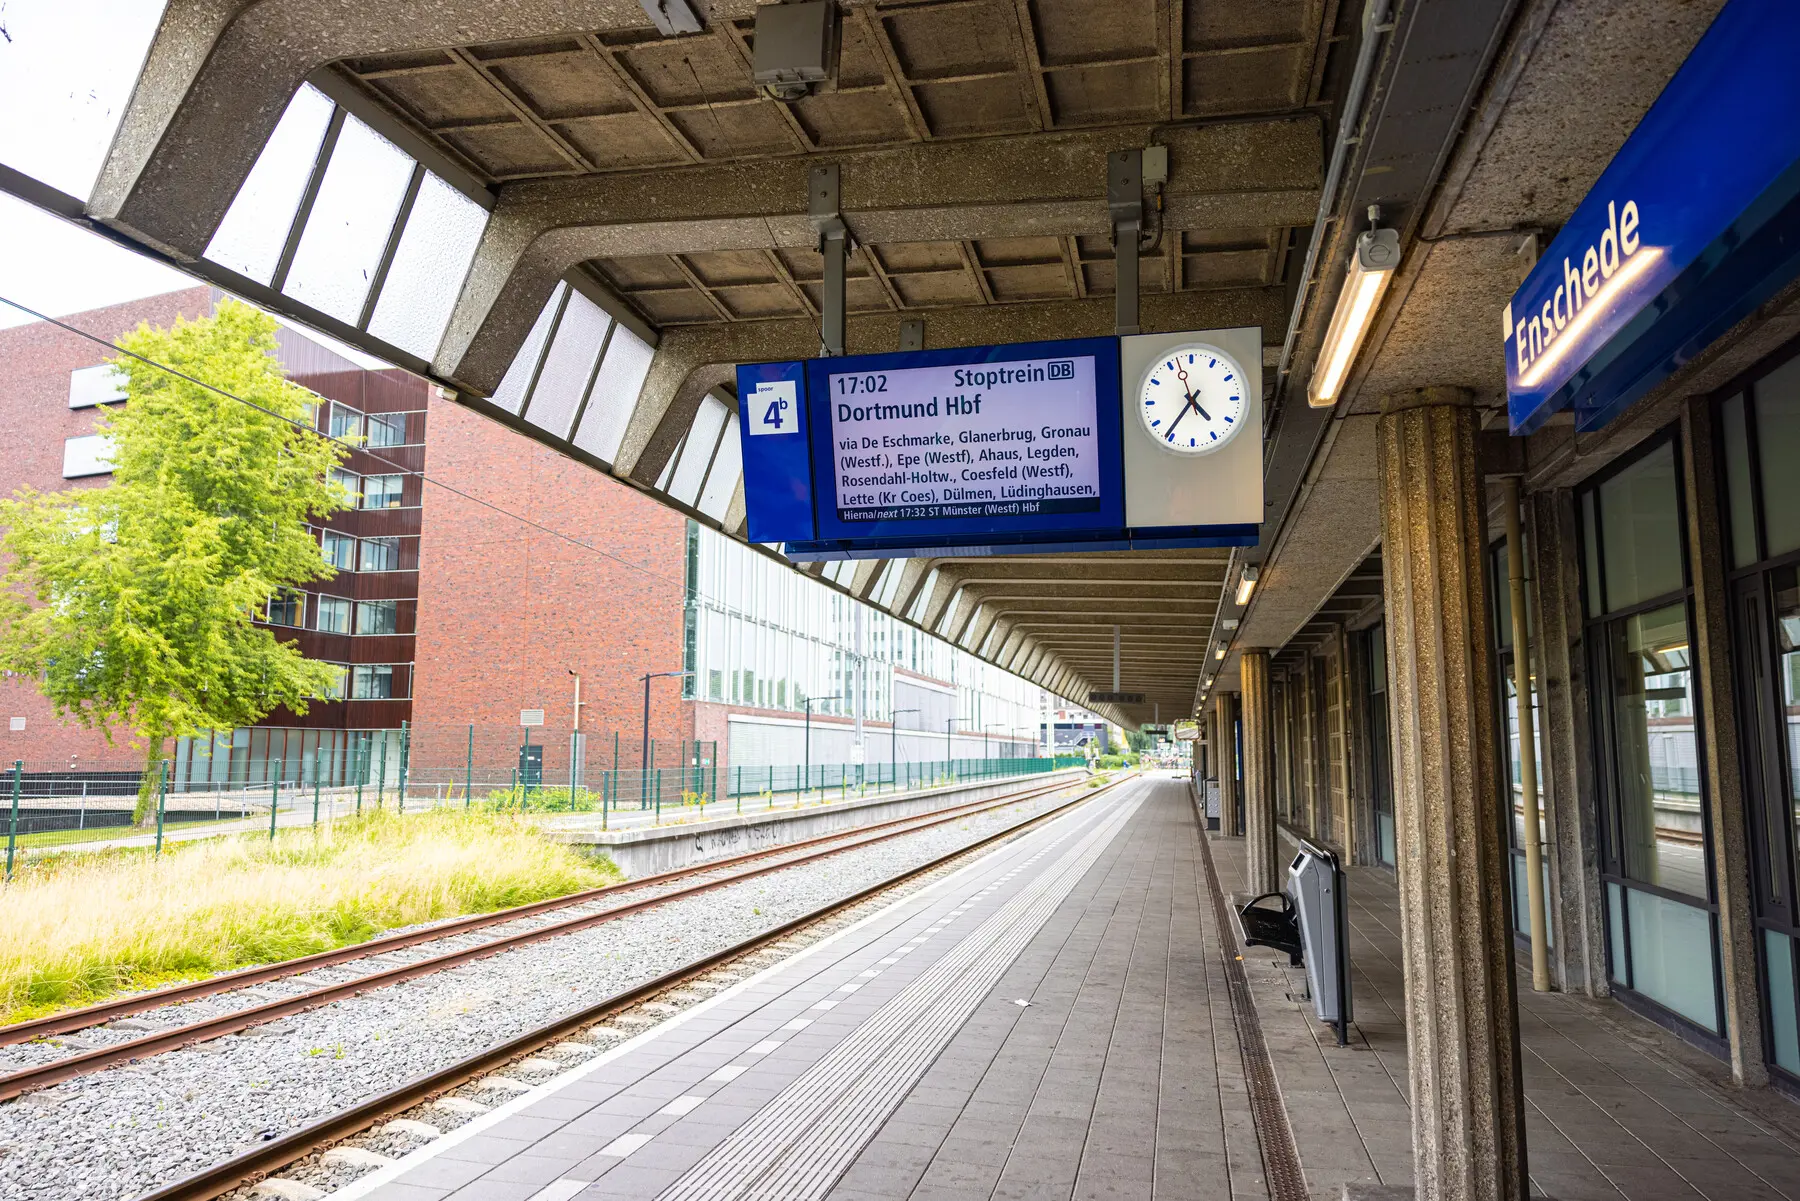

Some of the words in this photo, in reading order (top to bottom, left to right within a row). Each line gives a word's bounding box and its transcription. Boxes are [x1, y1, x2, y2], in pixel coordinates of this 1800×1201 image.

[1516, 200, 1640, 375] Enschede
[838, 375, 888, 394] 17:02
[954, 364, 1044, 390] Stoptrein
[1050, 362, 1072, 378] DB
[838, 397, 938, 422] Dortmund
[945, 394, 982, 416] Hbf
[840, 438, 858, 450] via
[862, 437, 878, 449] De
[883, 432, 954, 448] Eschmarke,
[959, 428, 1036, 443] Glanerbrug,
[1041, 426, 1090, 439] Gronau
[840, 454, 893, 470] (Westf.),
[898, 454, 920, 468] Epe
[924, 449, 974, 466] (Westf),
[979, 448, 1022, 461] Ahaus,
[1027, 444, 1079, 461] Legden,
[842, 470, 956, 487] Rosendahl-Holtw.,
[961, 466, 1018, 481] Coesfeld
[1022, 463, 1073, 480] (Westf),
[843, 493, 874, 506] Lette
[879, 492, 896, 506] (Kr
[900, 489, 939, 504] Coes),
[944, 487, 996, 502] Dülmen,
[1001, 483, 1096, 500] Lüdinghausen,
[844, 508, 898, 520] Hierna/next
[900, 507, 926, 518] 17:32
[928, 506, 940, 516] ST
[942, 504, 982, 516] Münster
[984, 503, 1020, 516] (Westf)
[1022, 502, 1040, 513] Hbf
